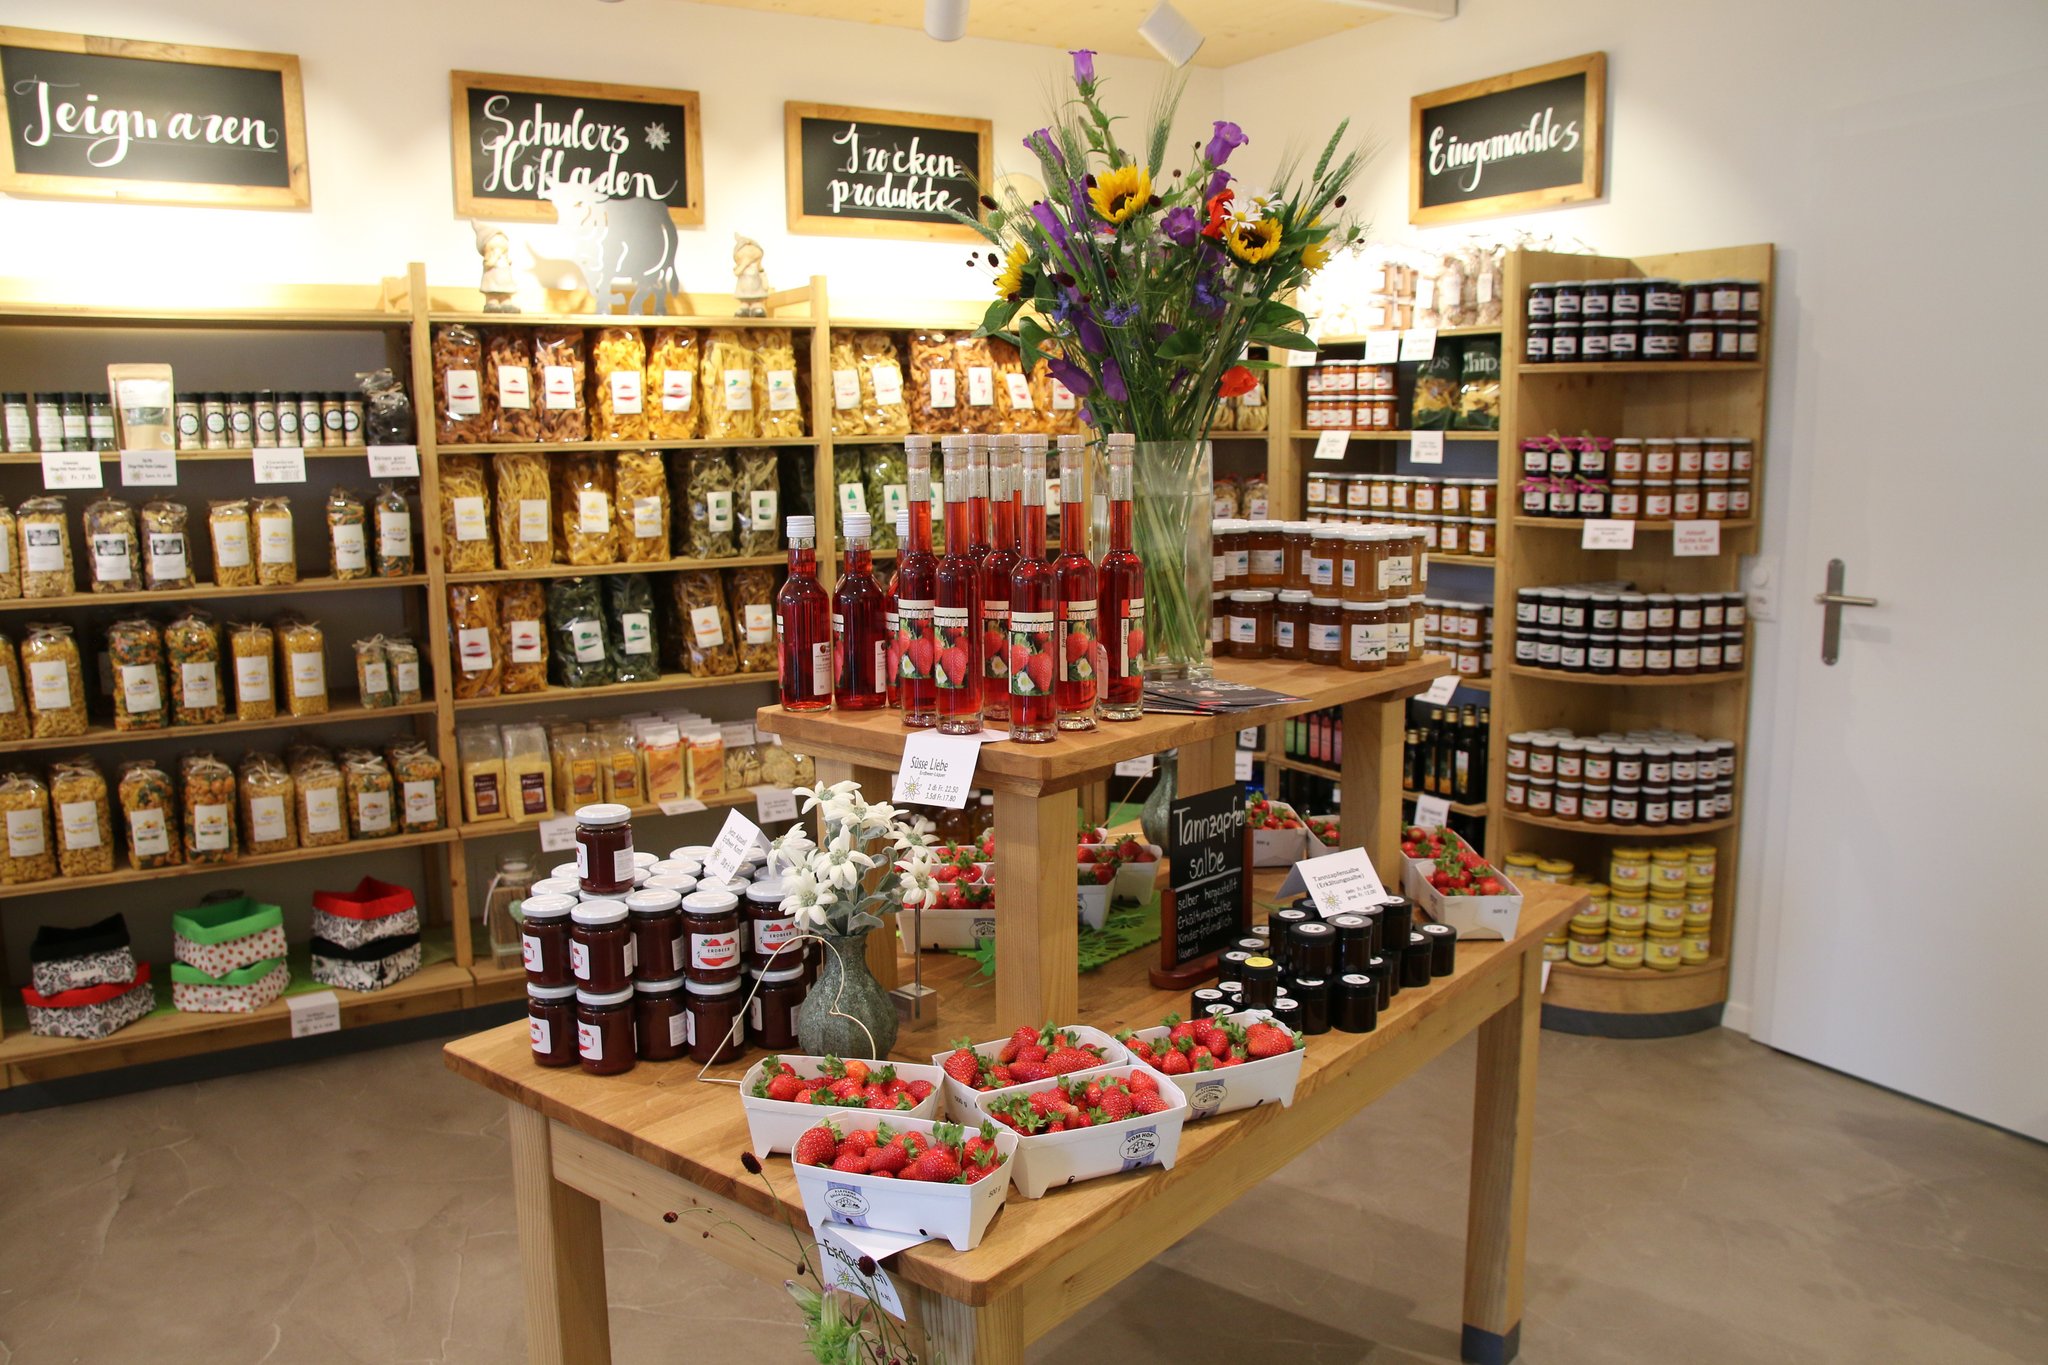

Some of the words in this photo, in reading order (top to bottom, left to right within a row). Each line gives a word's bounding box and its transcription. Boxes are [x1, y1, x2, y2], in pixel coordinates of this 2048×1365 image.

[13, 75, 279, 167] Teigwaren
[482, 95, 629, 154] Schuler's
[1429, 107, 1579, 192] Eingemachtes
[827, 172, 961, 213] produkte
[910, 756, 928, 770] Süsse
[929, 758, 948, 772] Liebe
[1173, 795, 1245, 846] Tannzapfen
[1189, 848, 1226, 880] salbe
[1312, 867, 1360, 882] Tannzapfensalbe
[1178, 892, 1199, 911] selber
[1204, 878, 1238, 904] hergestellt
[707, 946, 731, 954] ERDBEER
[769, 931, 792, 939] ERDBEER
[1127, 1133, 1141, 1143] VOM
[823, 1238, 889, 1287] Erdbeen
